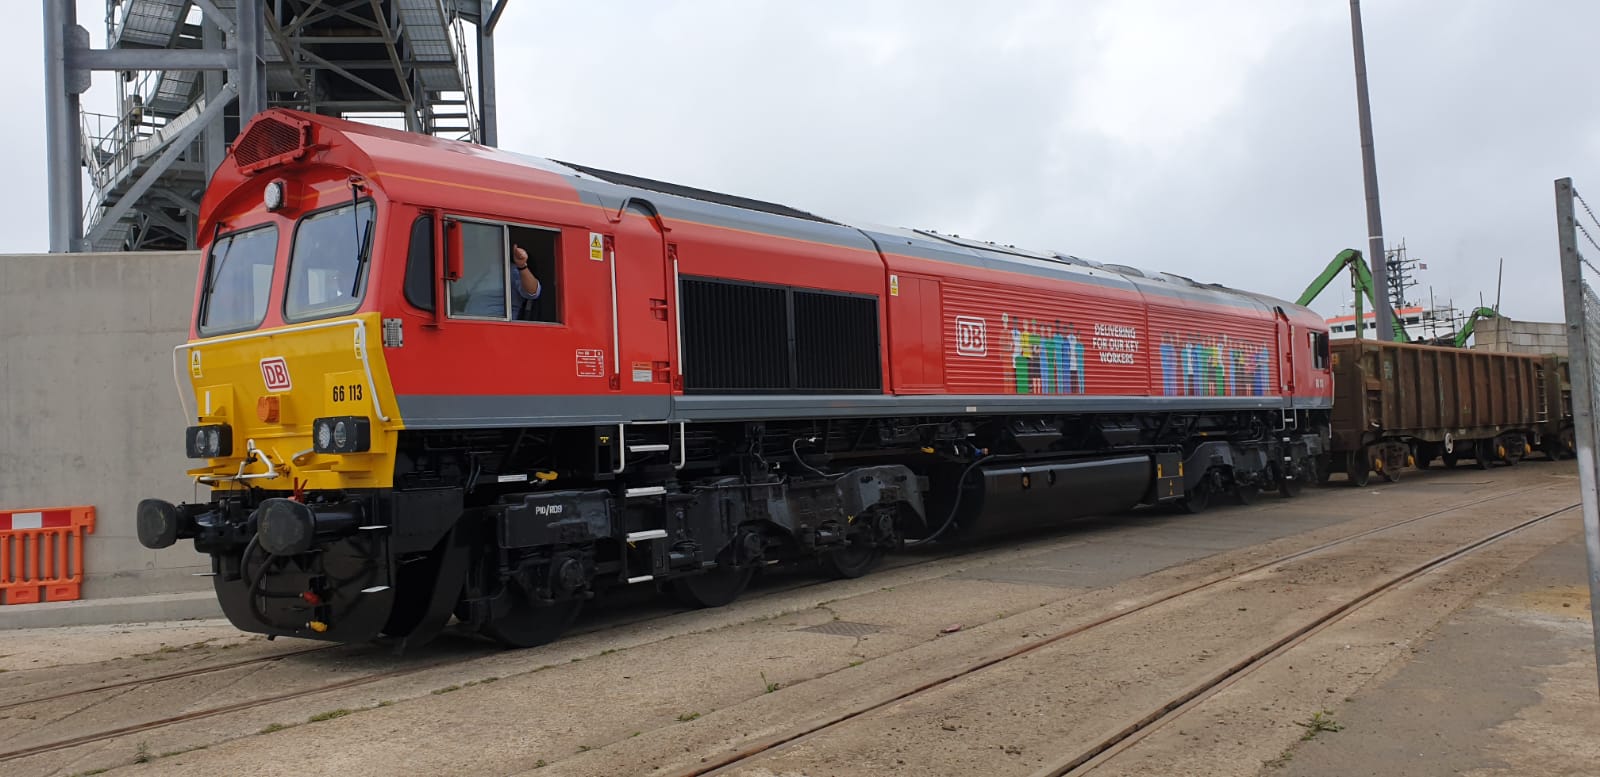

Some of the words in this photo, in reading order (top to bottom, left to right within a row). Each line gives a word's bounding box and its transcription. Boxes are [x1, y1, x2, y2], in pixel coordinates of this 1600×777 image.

[959, 321, 984, 352] DB
[1094, 323, 1136, 338] DELIVERING
[1092, 337, 1107, 350] FOR
[1109, 338, 1124, 351] OUR
[1126, 340, 1139, 352] KEY
[1099, 351, 1135, 364] WORKERS
[262, 361, 288, 387] DB
[333, 385, 345, 402] 66
[349, 384, 362, 401] 113
